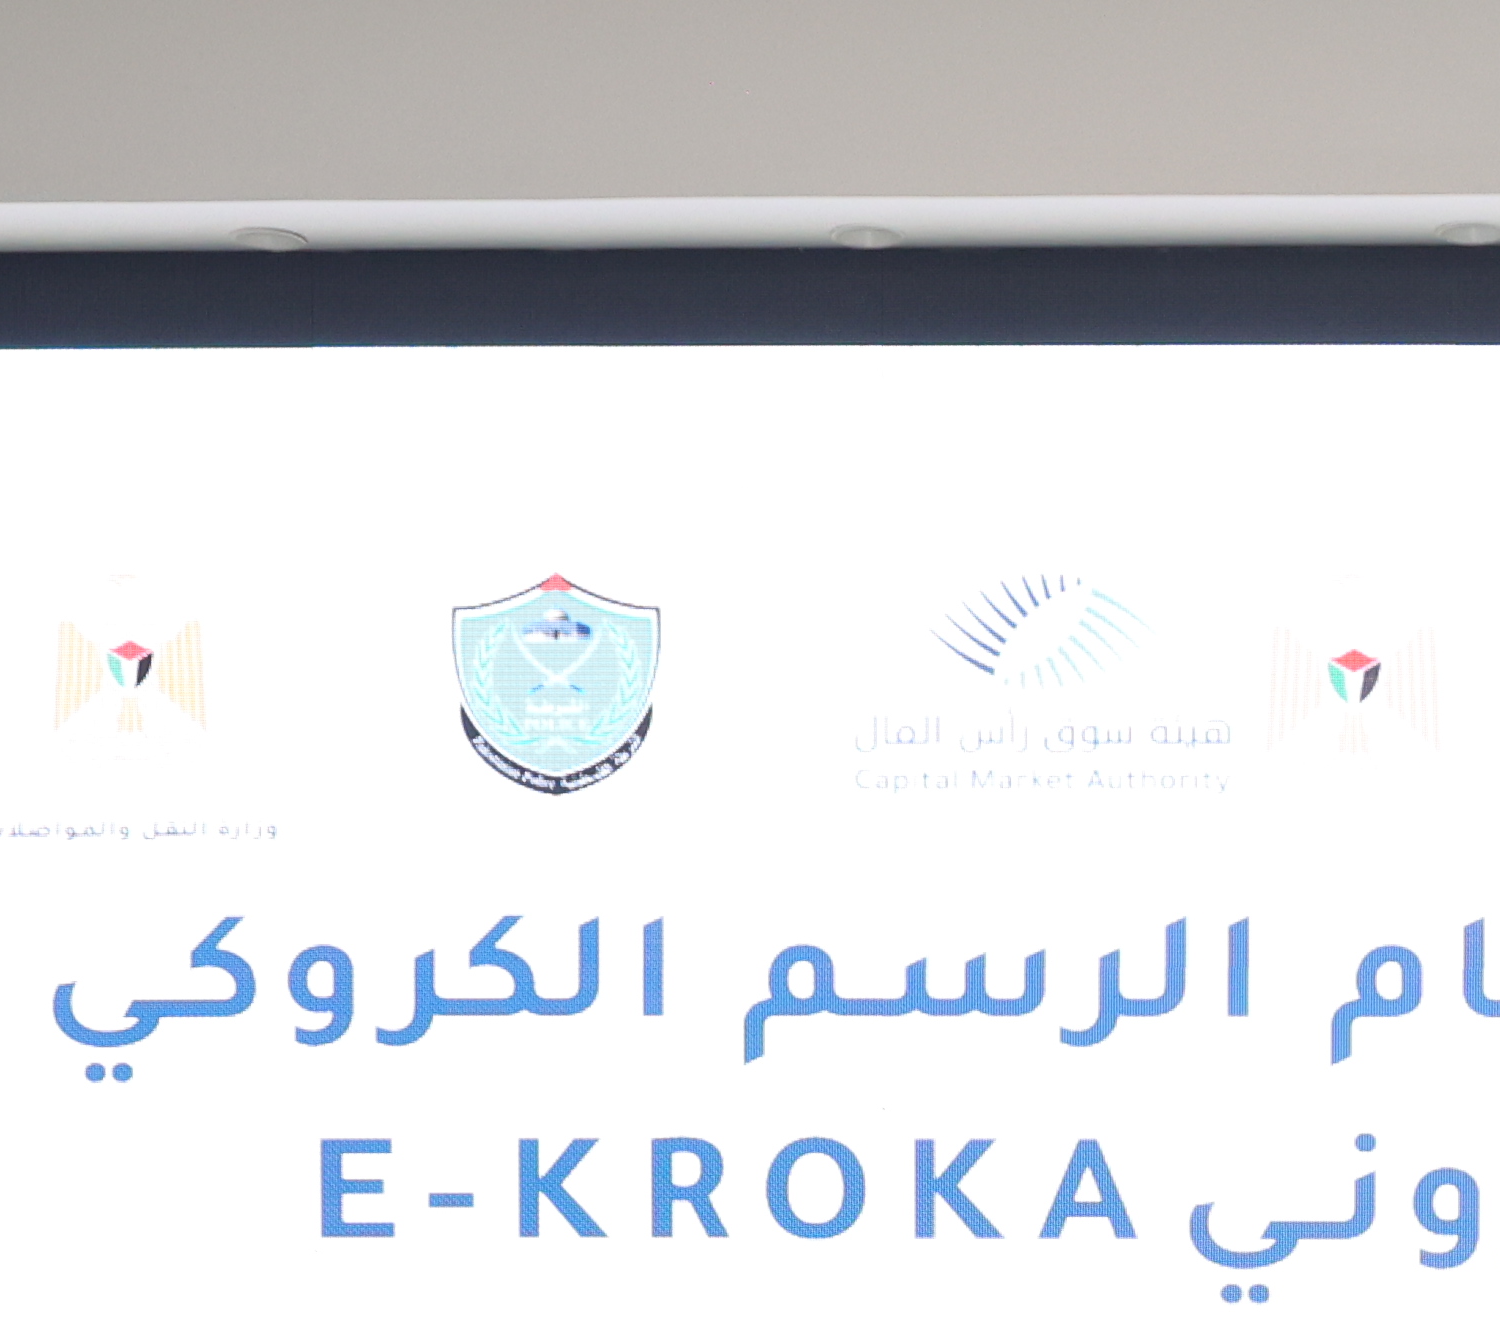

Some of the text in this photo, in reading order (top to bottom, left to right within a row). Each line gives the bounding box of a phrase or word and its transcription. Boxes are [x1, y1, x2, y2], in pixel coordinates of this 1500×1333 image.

[853, 714, 942, 754] المال
[957, 706, 1031, 754] رأس
[1041, 718, 1135, 754] سوق
[853, 767, 1232, 795] Capital Market Authority
[51, 915, 666, 1083] الكروكي
[743, 917, 1251, 1065] الرسم
[320, 1136, 1137, 1240] E-KROKA
